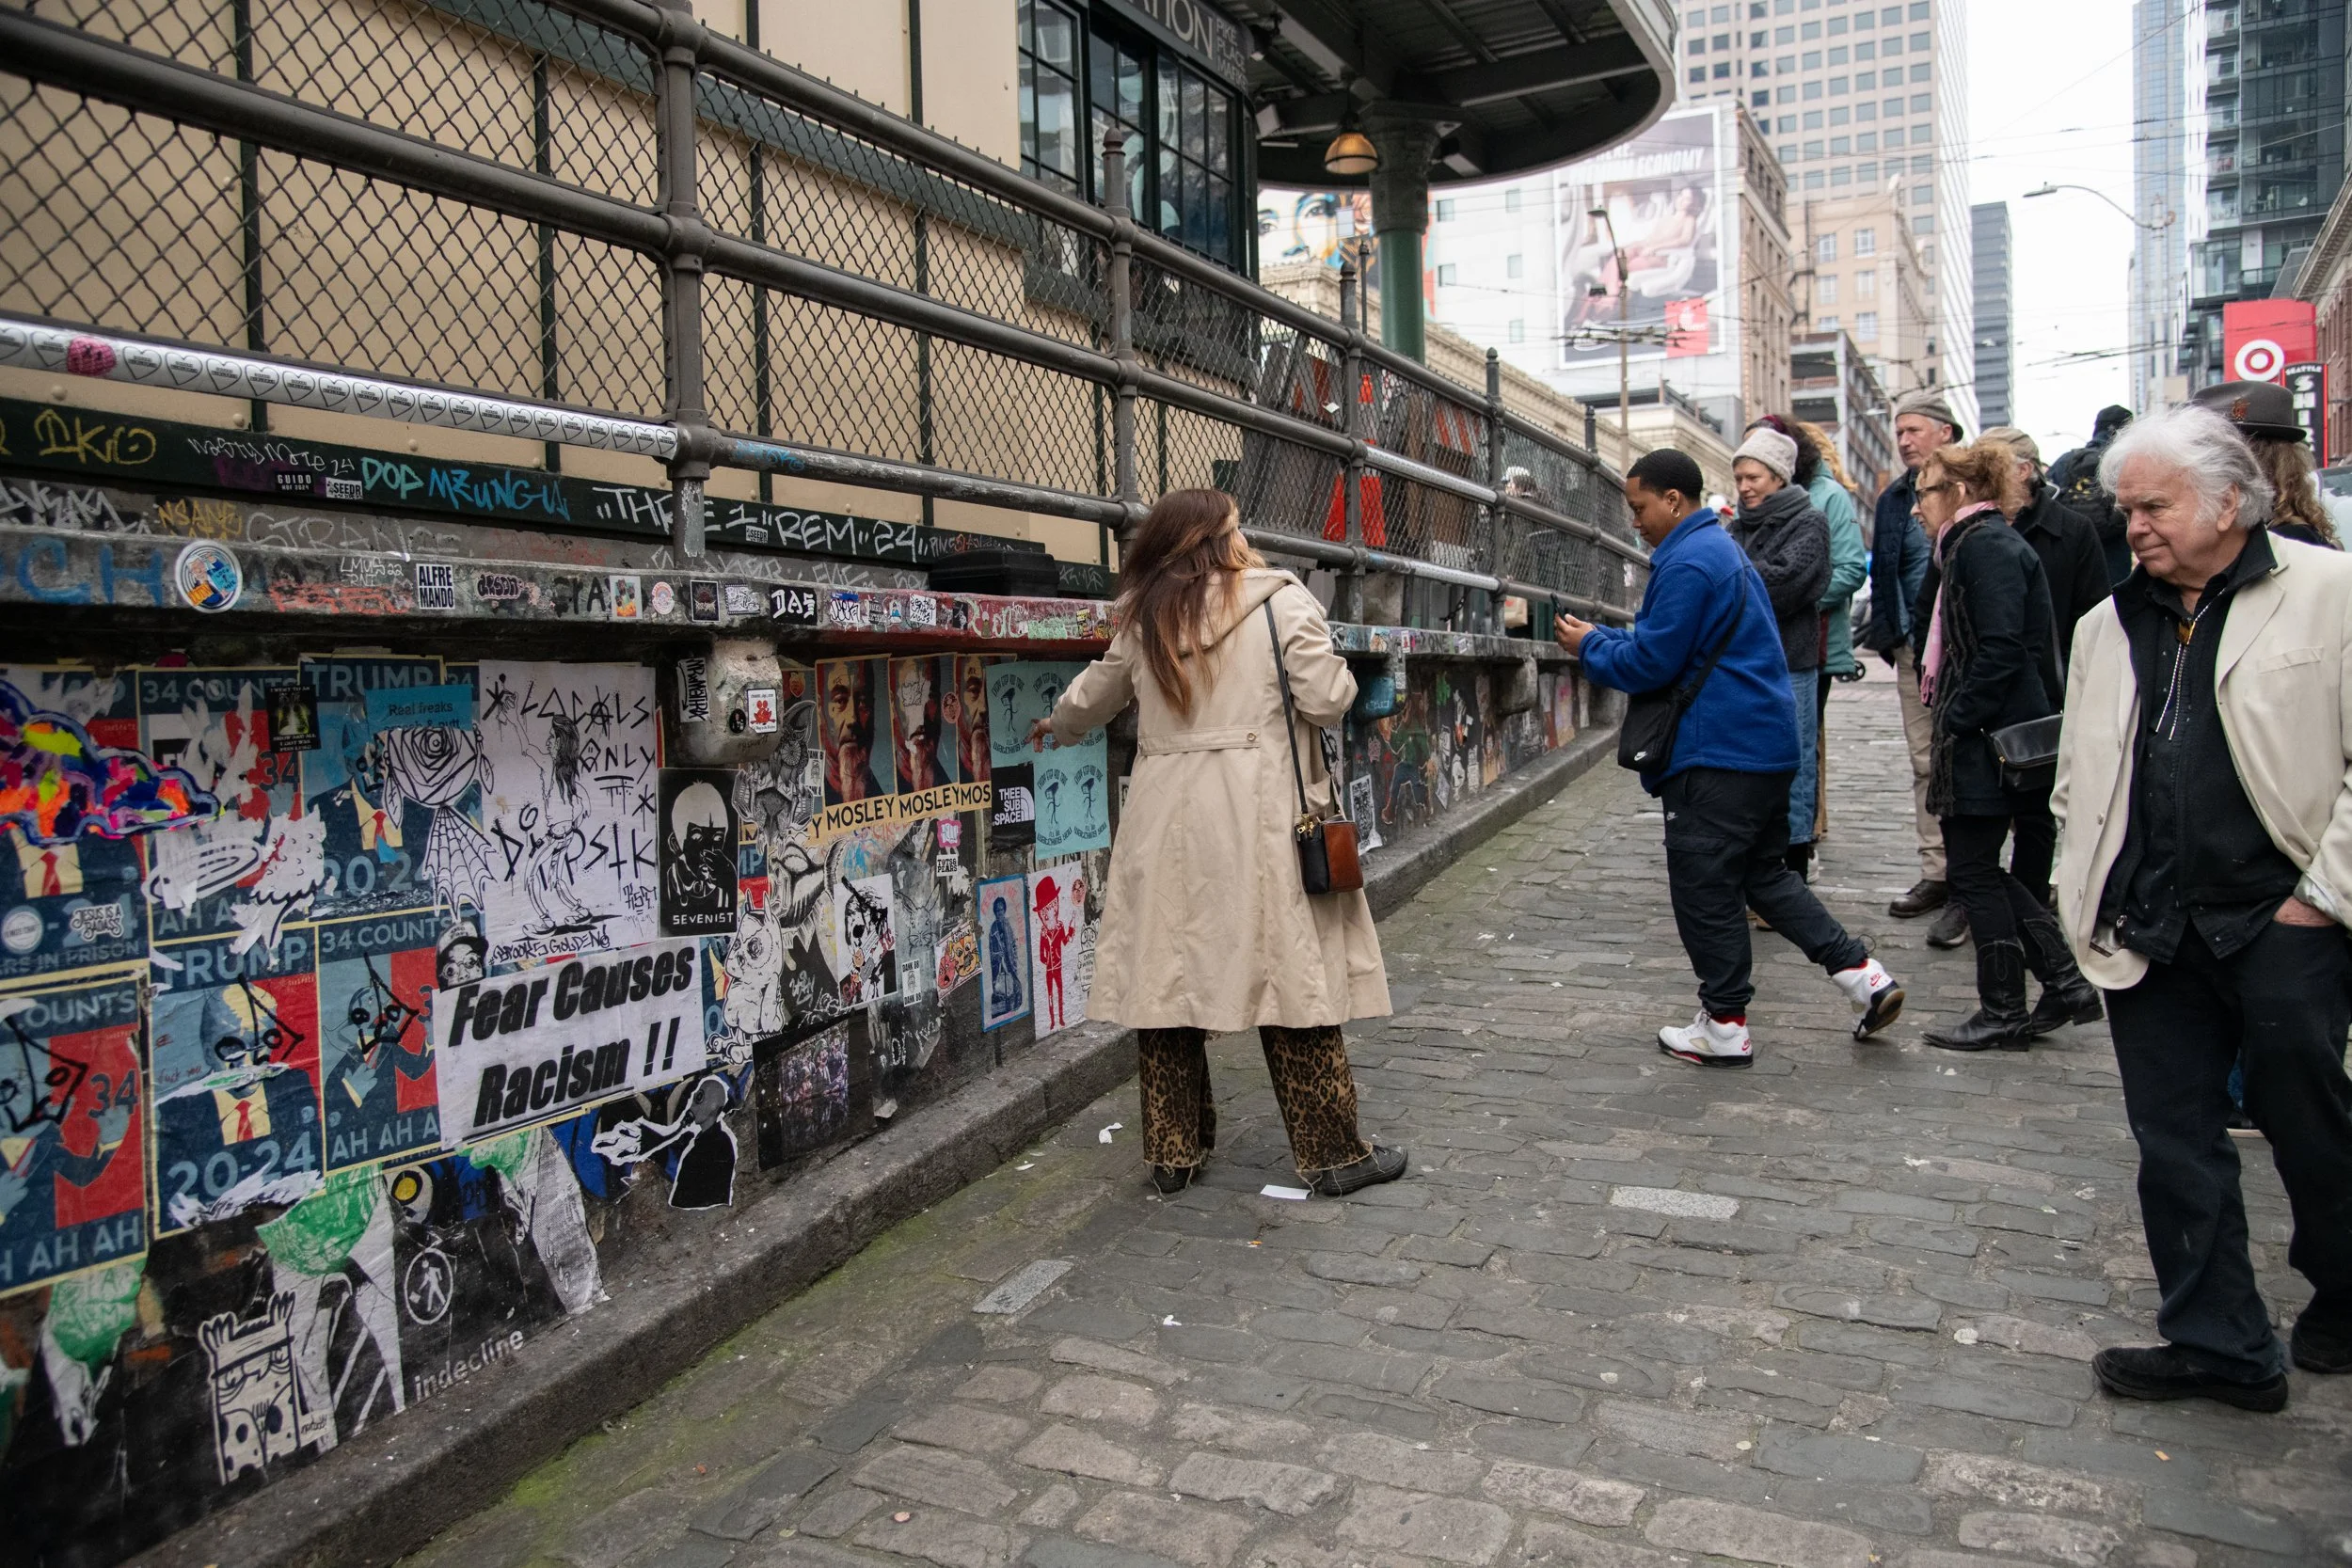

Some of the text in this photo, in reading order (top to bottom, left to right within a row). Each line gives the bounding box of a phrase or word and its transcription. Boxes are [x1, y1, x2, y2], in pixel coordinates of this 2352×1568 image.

[1635, 148, 1706, 177] ECONOMY
[2285, 365, 2323, 376] SEATTLE
[278, 474, 311, 484] GUIDO
[333, 483, 361, 496] SEEDR
[420, 567, 453, 586] ALFRE
[420, 588, 453, 609] MANDO
[143, 679, 181, 704] 34
[304, 664, 434, 698] TRUMP
[389, 701, 453, 717] Real freaks
[259, 752, 299, 791] 34
[899, 785, 961, 818] MOSLEY
[961, 784, 991, 807] MOS
[999, 787, 1021, 800] THEE
[826, 797, 897, 831] MOSLEY
[993, 812, 1021, 826] SPACE
[1004, 800, 1021, 813] SUB
[937, 864, 957, 873] PEARS
[72, 905, 122, 929] JESUS IS A
[83, 918, 123, 940] BADASS
[158, 909, 203, 936] AH
[673, 911, 734, 926] SEVENIST
[323, 915, 453, 953] 34 COUNTS
[67, 941, 139, 964] PRISON
[160, 936, 309, 985] TRUMP
[449, 946, 696, 1048] Fear Causes
[473, 1016, 681, 1128] Racism !!
[87, 1069, 138, 1119] 34
[331, 1127, 368, 1164] AH
[378, 1117, 413, 1150] AH
[422, 1111, 440, 1139] A
[167, 1131, 315, 1201] 20-24
[27, 1234, 79, 1272] AH
[96, 1216, 140, 1258] AH
[414, 1330, 524, 1402] indecline
